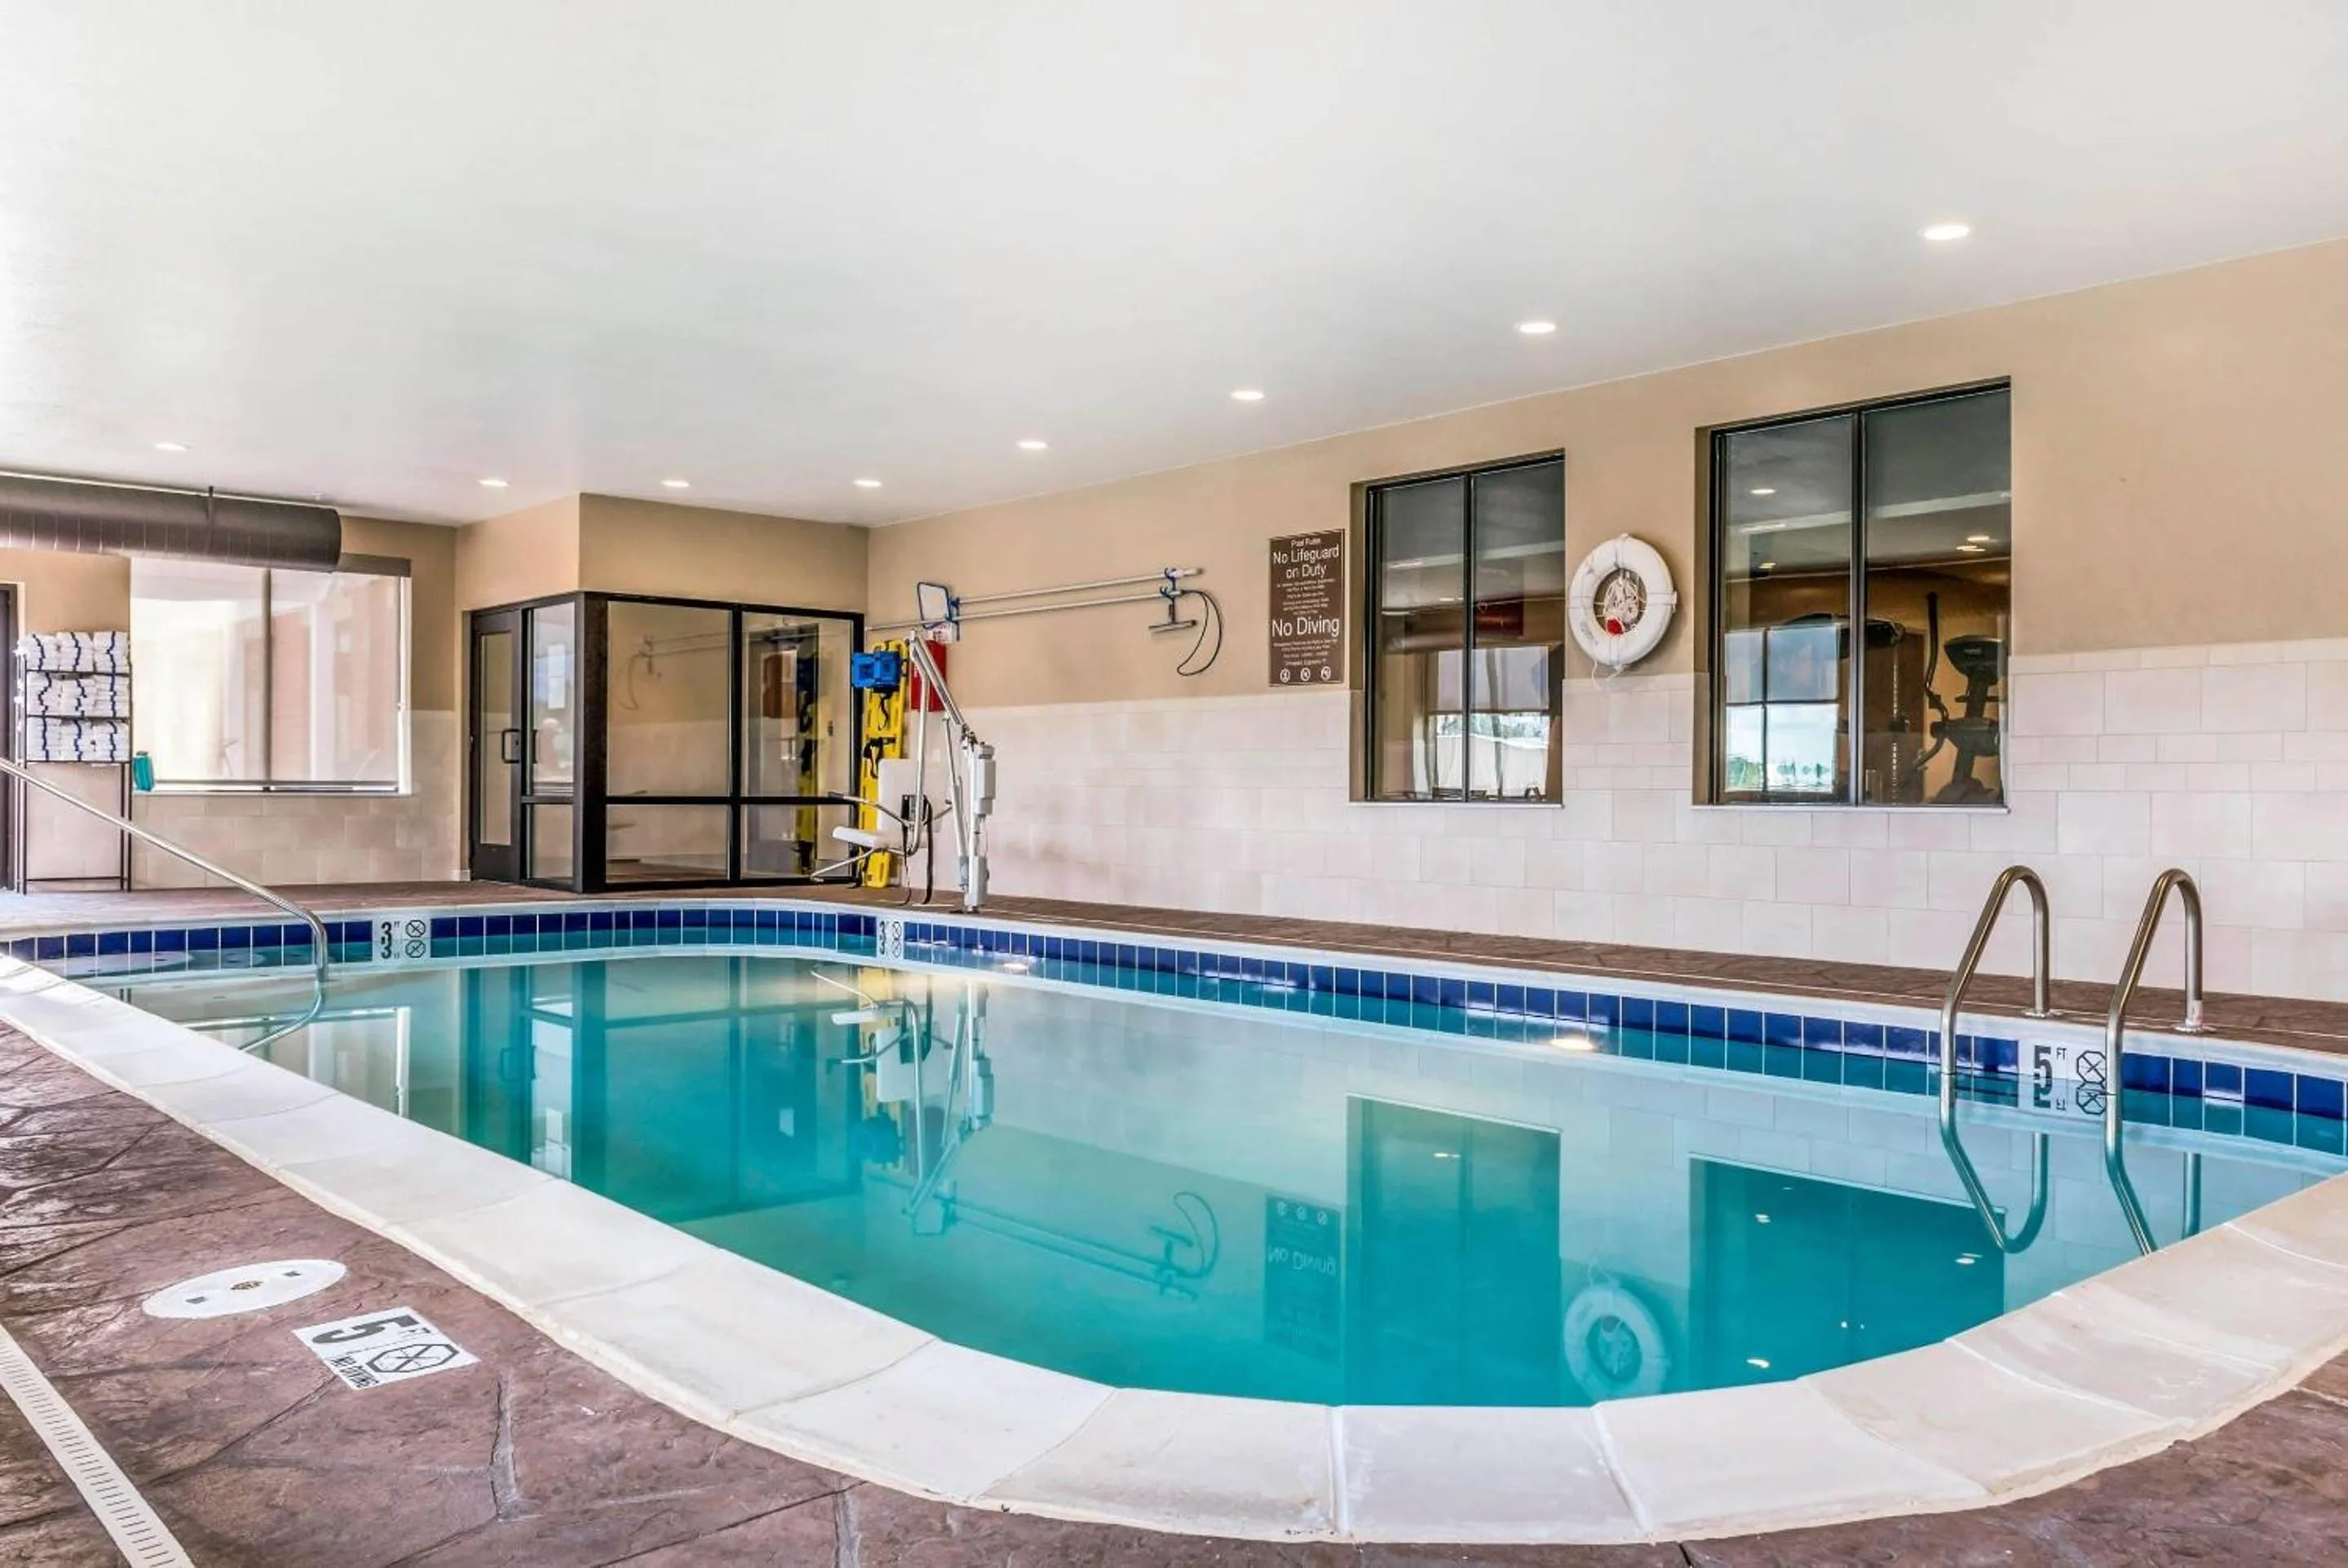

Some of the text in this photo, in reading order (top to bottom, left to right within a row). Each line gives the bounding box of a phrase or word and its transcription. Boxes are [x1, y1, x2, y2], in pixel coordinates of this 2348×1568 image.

[1273, 544, 1339, 565] No Lifeguard
[1286, 563, 1327, 580] on Duty
[1271, 615, 1340, 638] No Diving
[381, 921, 391, 942] 3
[2034, 1045, 2067, 1079] 5 FT
[312, 1314, 421, 1344] 5
